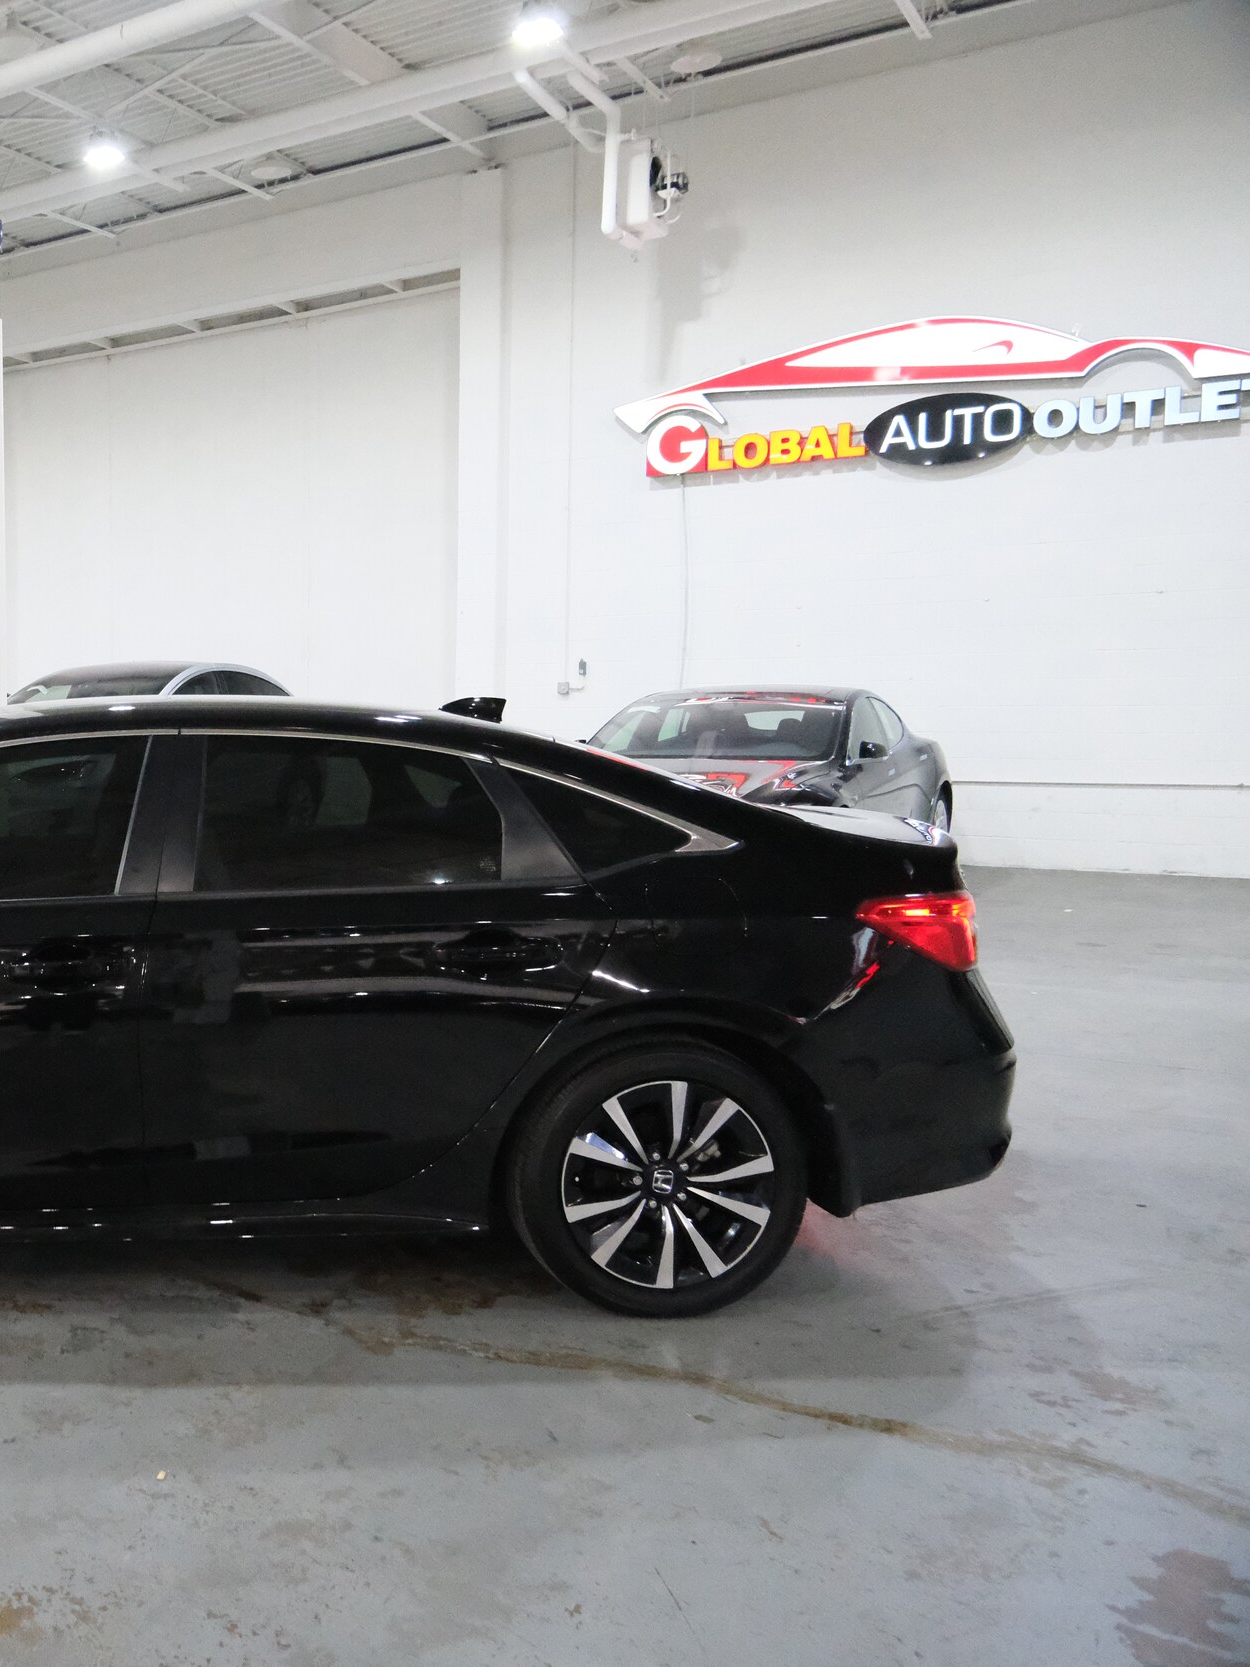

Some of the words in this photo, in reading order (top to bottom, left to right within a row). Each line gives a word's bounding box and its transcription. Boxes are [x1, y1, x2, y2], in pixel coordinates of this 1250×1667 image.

[646, 414, 866, 476] GLOBAL
[879, 402, 1022, 454] AUTO
[1033, 378, 1250, 439] OUTLE
